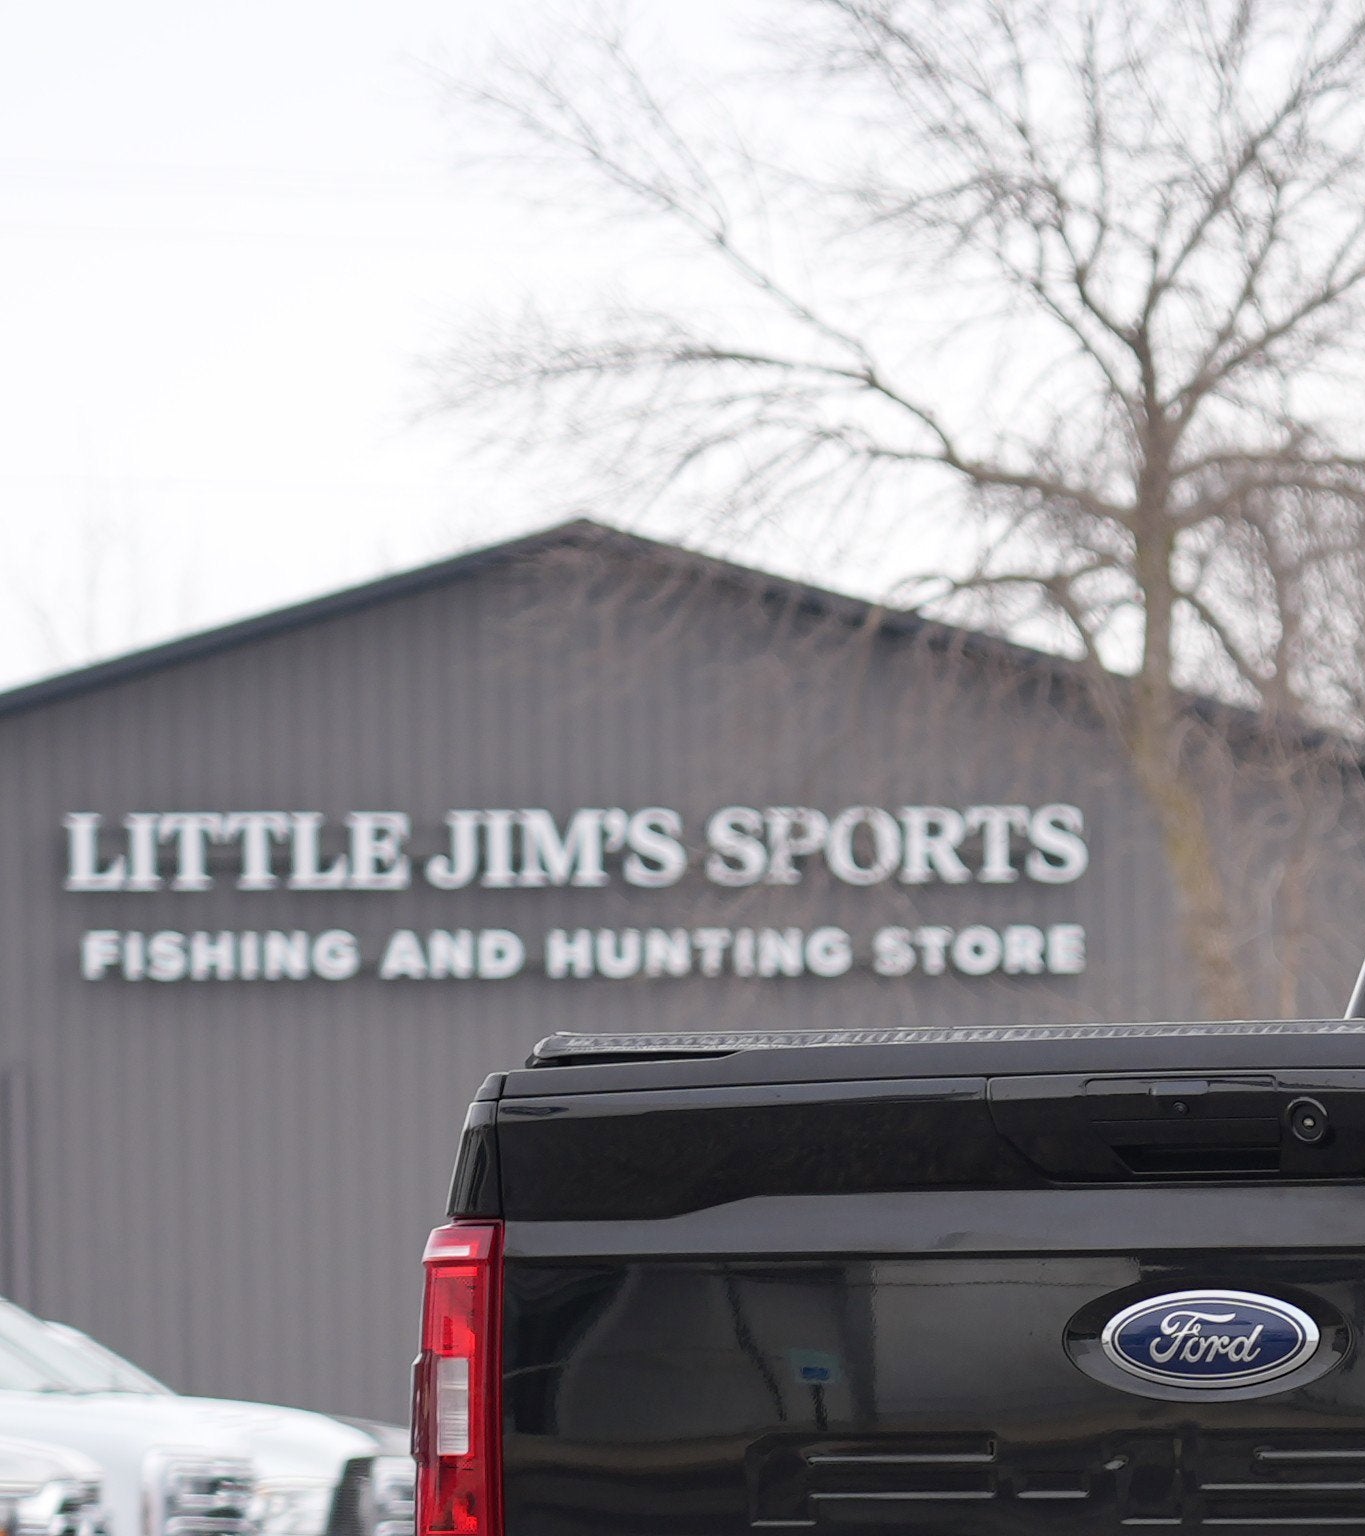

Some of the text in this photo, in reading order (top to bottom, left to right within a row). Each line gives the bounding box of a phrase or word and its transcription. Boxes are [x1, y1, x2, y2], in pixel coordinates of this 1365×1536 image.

[64, 803, 1090, 891] LITTLE JIM'S SPORTS
[82, 923, 1087, 980] FISHING AND HUNTING STORE
[1150, 1310, 1264, 1363] Ford
